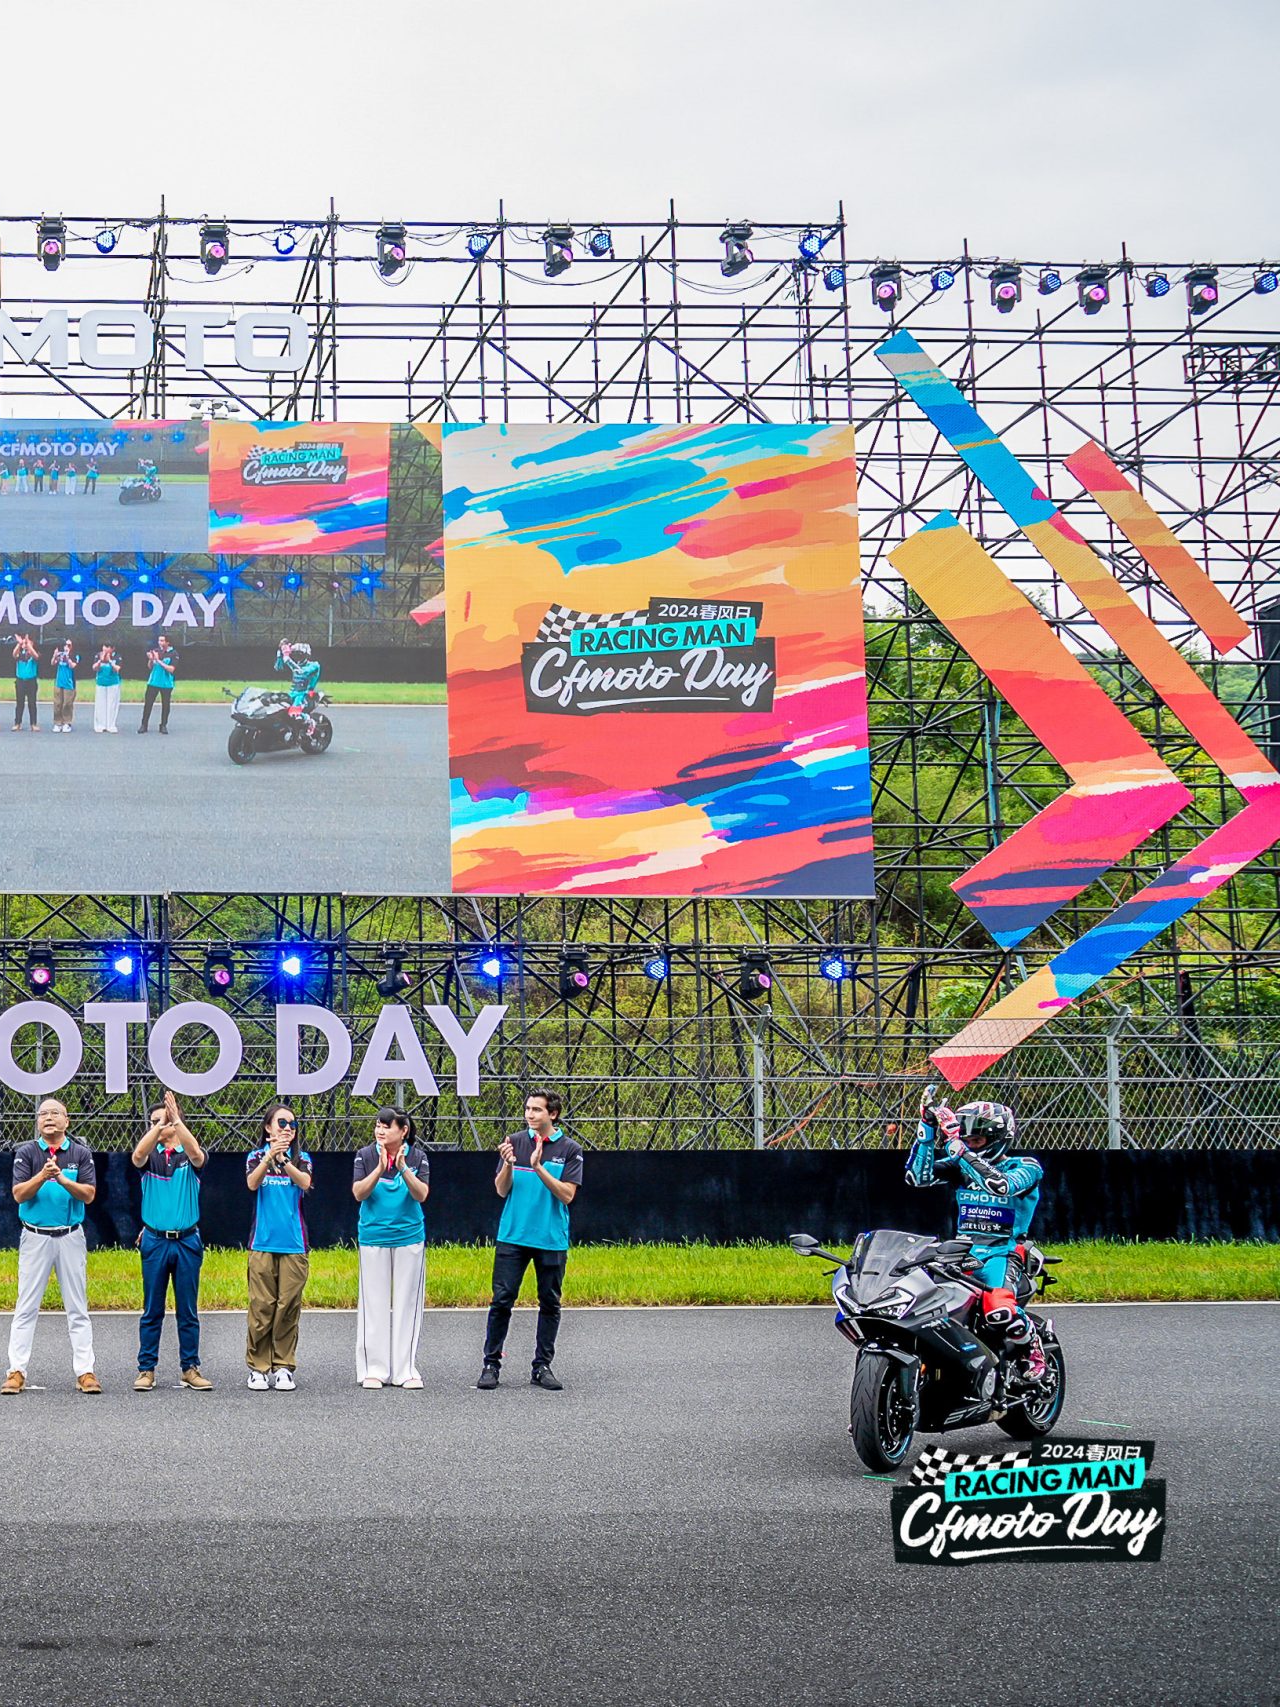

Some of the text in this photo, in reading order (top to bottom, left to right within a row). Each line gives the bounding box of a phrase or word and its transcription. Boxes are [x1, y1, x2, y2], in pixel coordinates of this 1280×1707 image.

[0, 442, 76, 456] CFMOTO
[80, 442, 119, 456] DAY
[306, 460, 346, 483] Day
[131, 592, 226, 628] DAY
[579, 622, 746, 653] RACING MAN
[529, 646, 774, 707] Cfmoto Day
[276, 1003, 510, 1096] DAY
[959, 1192, 1008, 1205] CFMOTO
